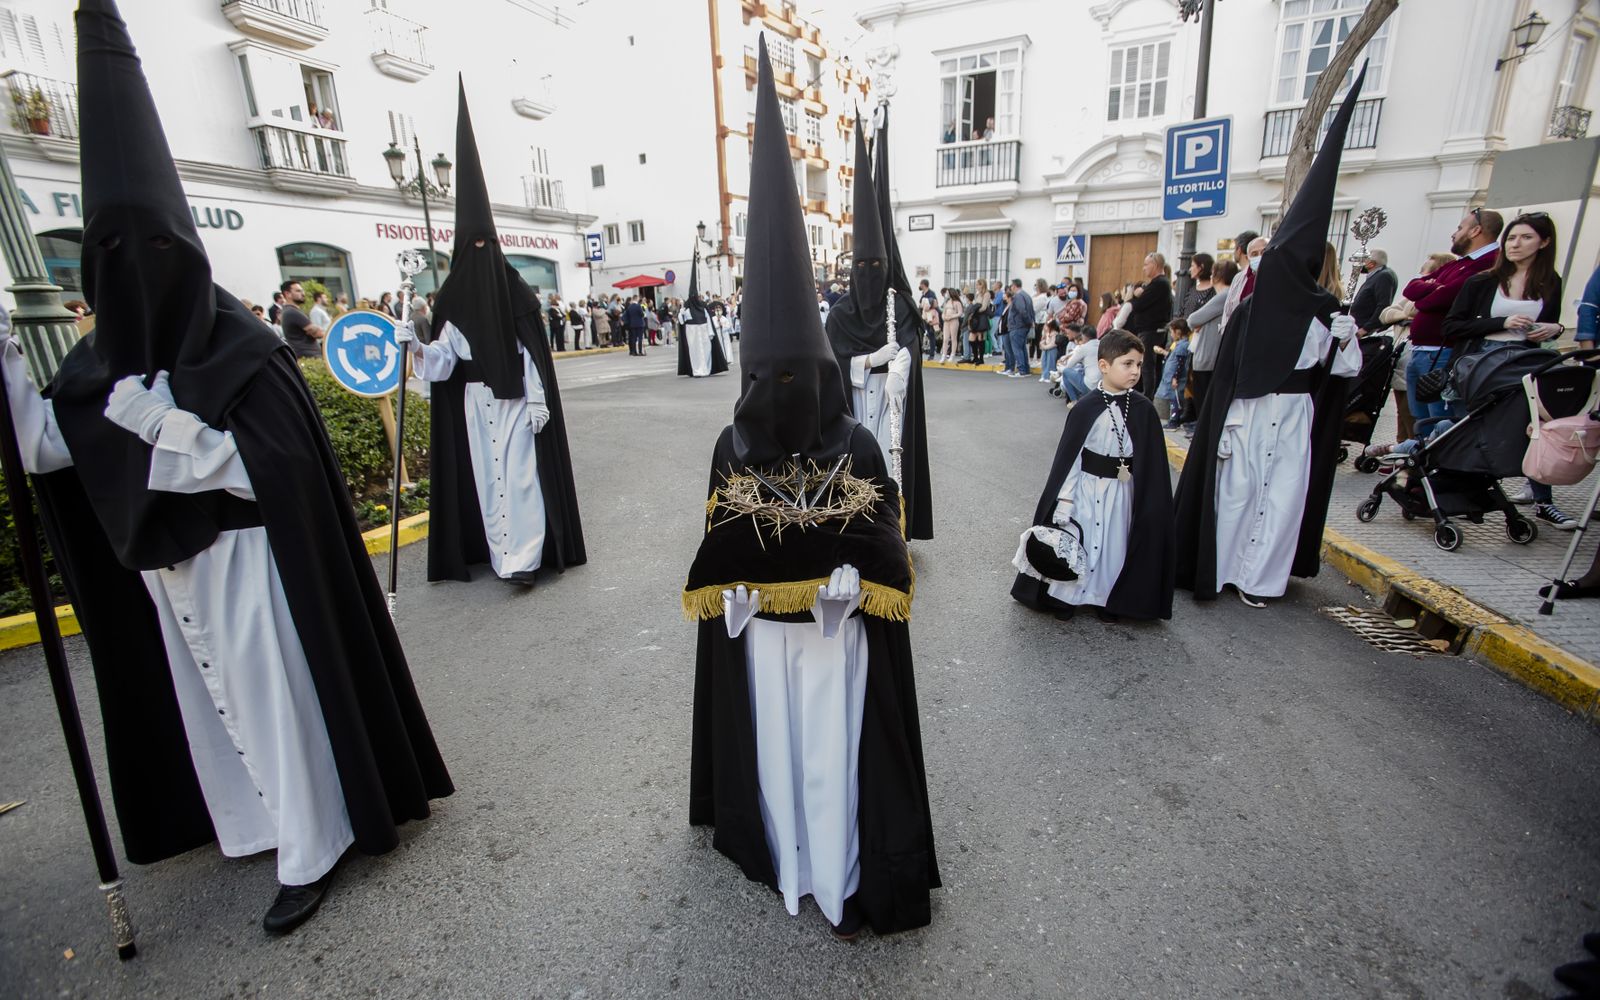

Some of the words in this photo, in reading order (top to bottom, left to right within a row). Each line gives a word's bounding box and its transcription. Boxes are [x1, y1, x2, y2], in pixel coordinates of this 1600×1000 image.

[1184, 135, 1213, 170] P
[1166, 179, 1225, 195] RETORTILLO
[190, 205, 245, 231] LUD
[376, 223, 454, 243] FISIOTERAP
[499, 233, 559, 250] ABILITACIÓN
